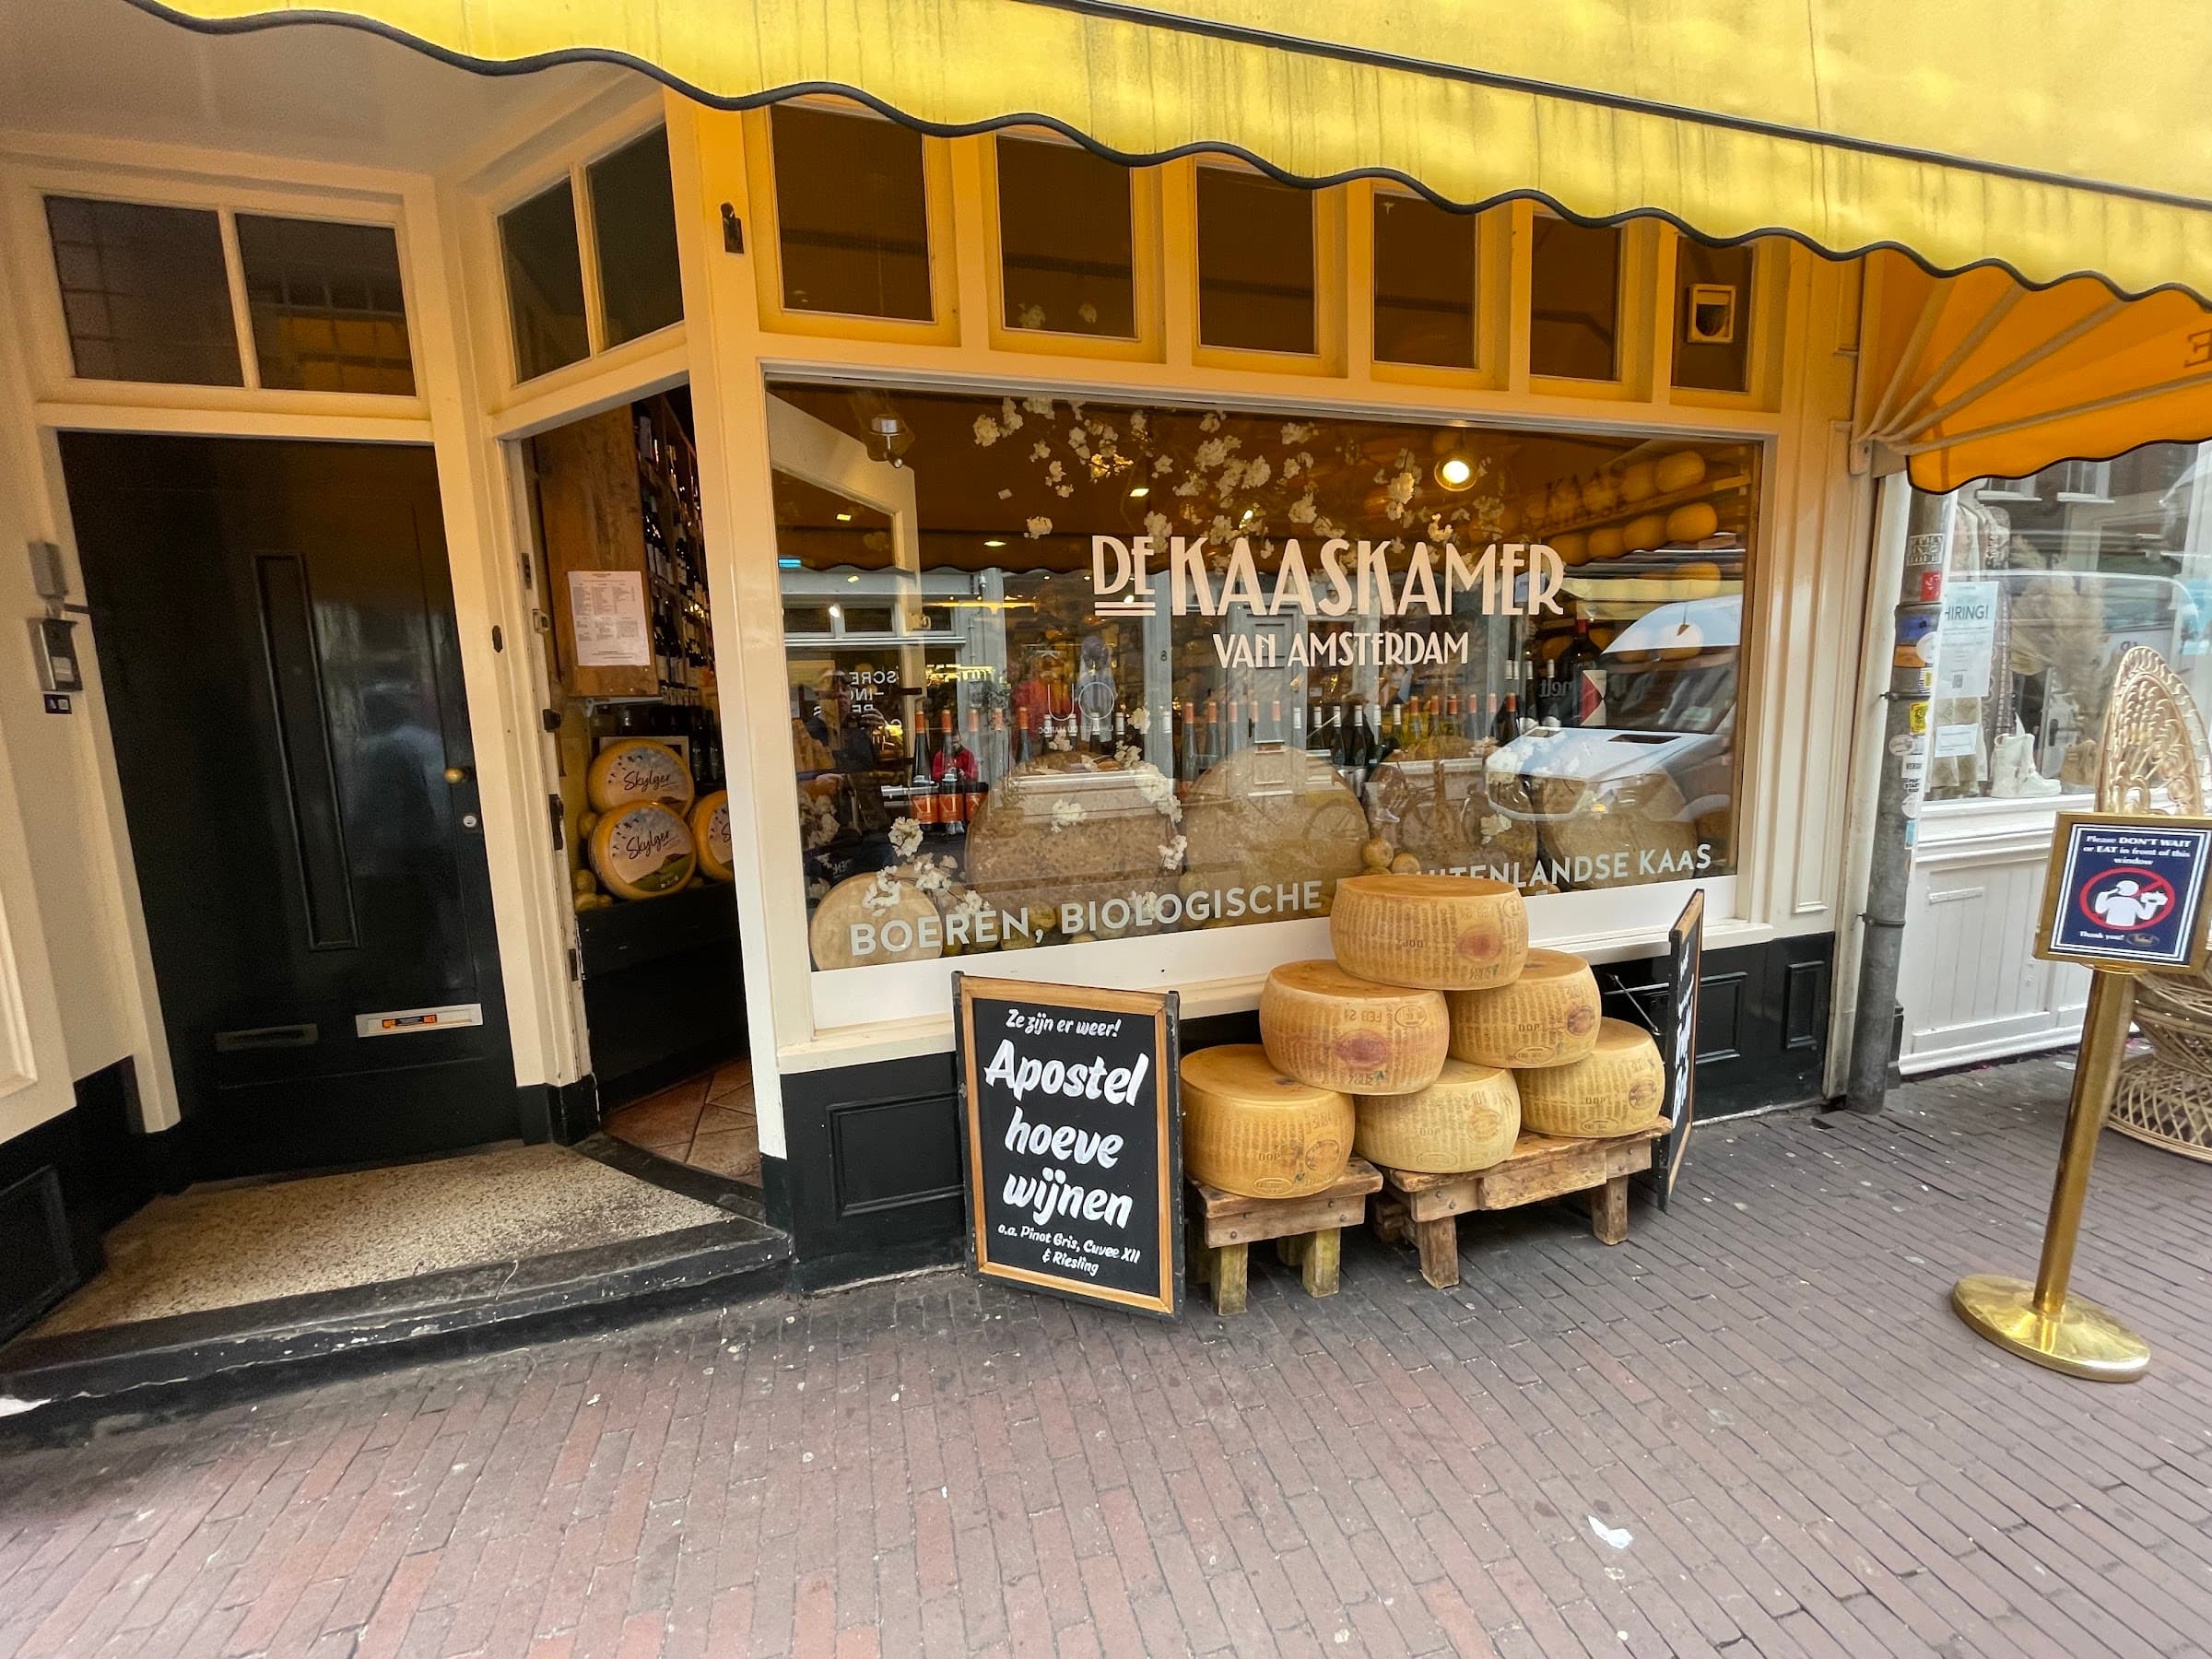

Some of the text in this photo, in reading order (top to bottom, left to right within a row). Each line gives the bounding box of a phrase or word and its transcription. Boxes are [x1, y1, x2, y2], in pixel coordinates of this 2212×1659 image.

[1092, 535, 1565, 616] DE KAASKAMER
[1213, 629, 1469, 668] VAN AMSTERDAM
[624, 771, 671, 793] Skylger
[626, 830, 671, 860] Skylger
[2087, 835, 2192, 848] Please DON'T WAIT
[2132, 847, 2156, 856] front
[2171, 850, 2191, 858] this
[2113, 857, 2153, 865] window
[850, 907, 1043, 956] BOEREN,
[1061, 880, 1324, 935] BIOLOGISCHE
[1639, 843, 1712, 876] KAAS
[2079, 930, 2103, 939] Thank
[1006, 1008, 1122, 1038] Ze zijn er weer!
[983, 1039, 1149, 1106] Apostel
[1004, 1106, 1124, 1169] hoeve
[1002, 1167, 1134, 1230] wijnen
[997, 1224, 1018, 1238] o.a.
[1020, 1225, 1052, 1244] Pinot
[1053, 1232, 1081, 1252] Gris,
[1082, 1239, 1121, 1260] Cuvee
[1053, 1252, 1100, 1277] Riesling
